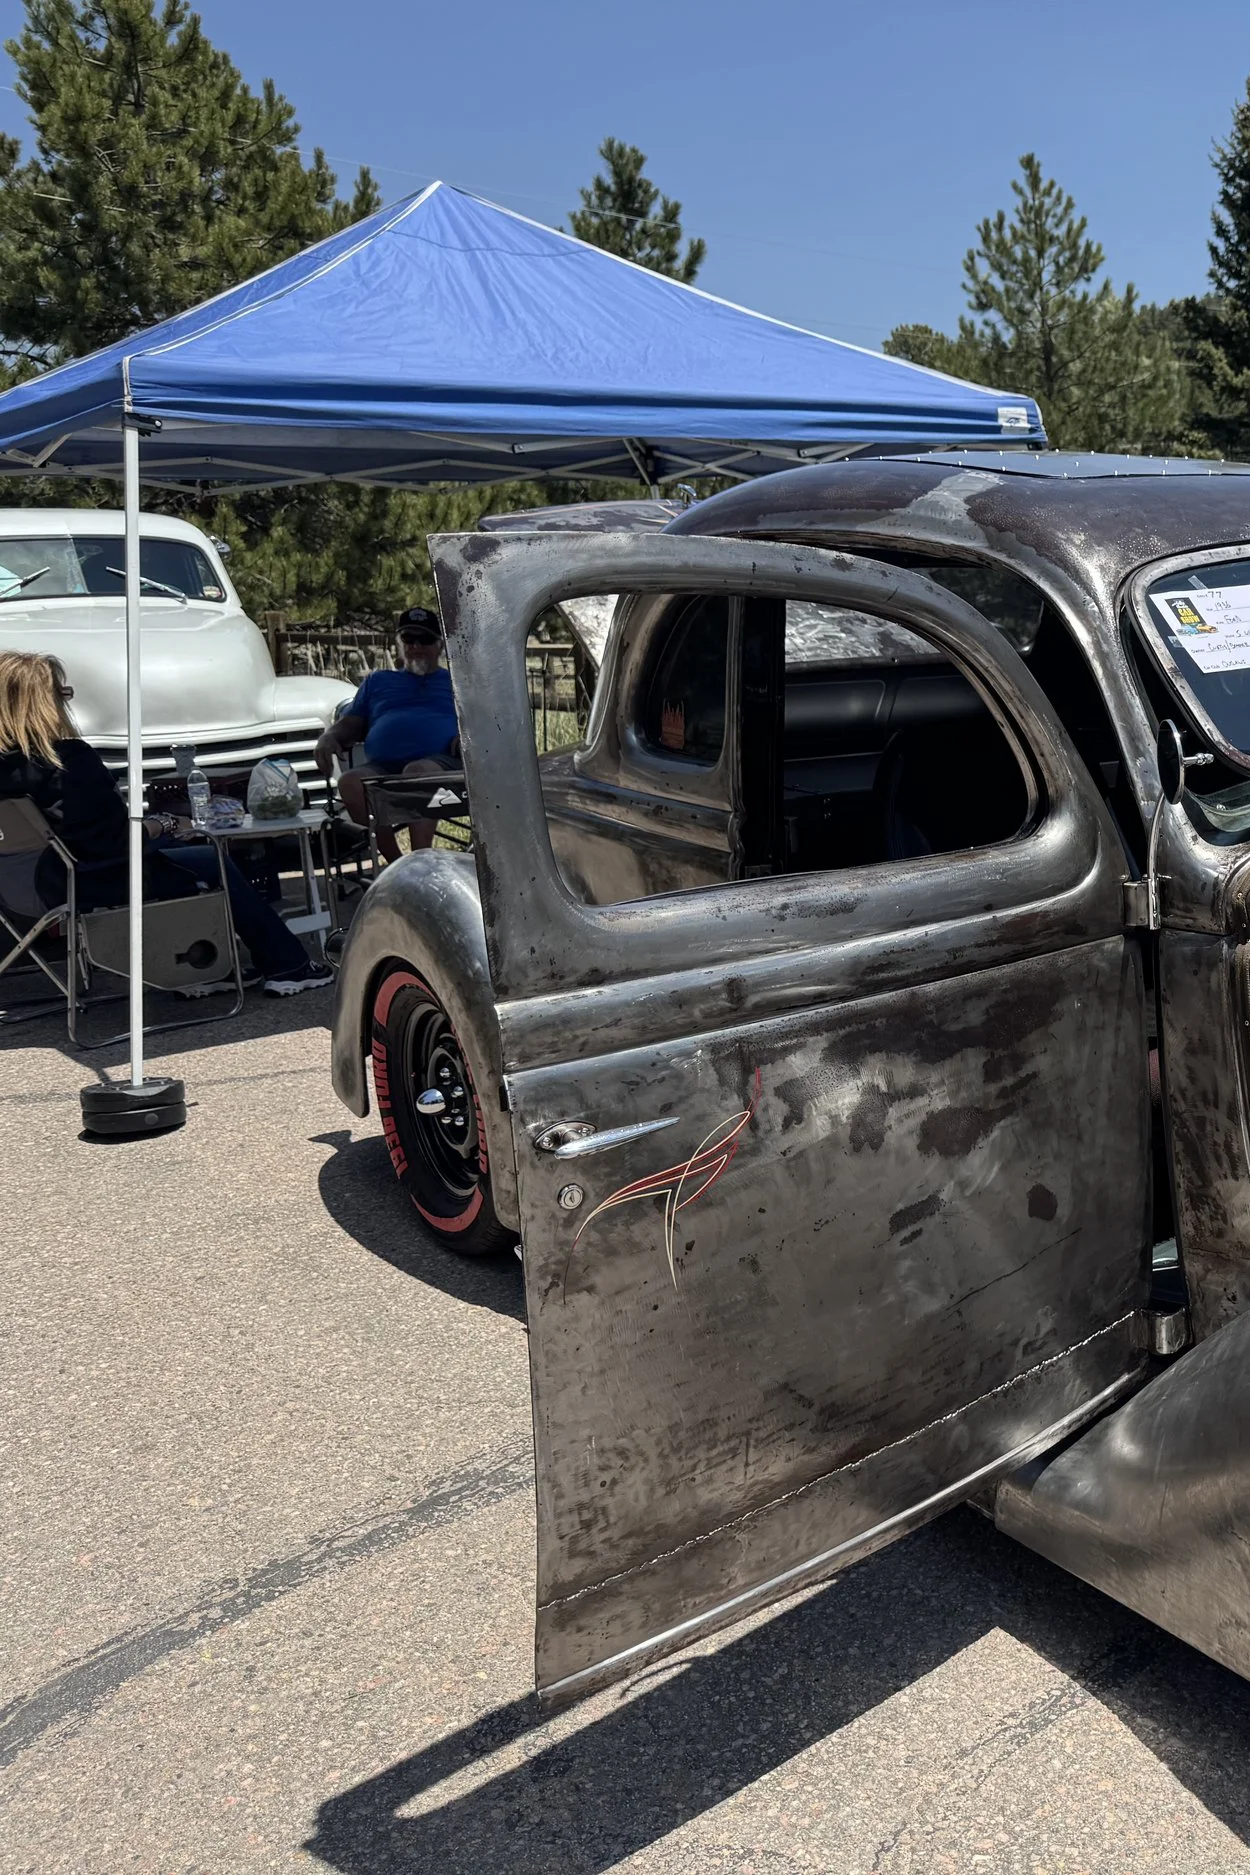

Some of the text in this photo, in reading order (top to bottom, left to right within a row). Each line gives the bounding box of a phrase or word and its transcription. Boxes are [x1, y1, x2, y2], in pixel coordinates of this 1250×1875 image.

[1207, 591, 1222, 599] 77
[1215, 601, 1231, 610] 1936
[1178, 608, 1194, 616] CAR
[1181, 615, 1199, 624] SHOW
